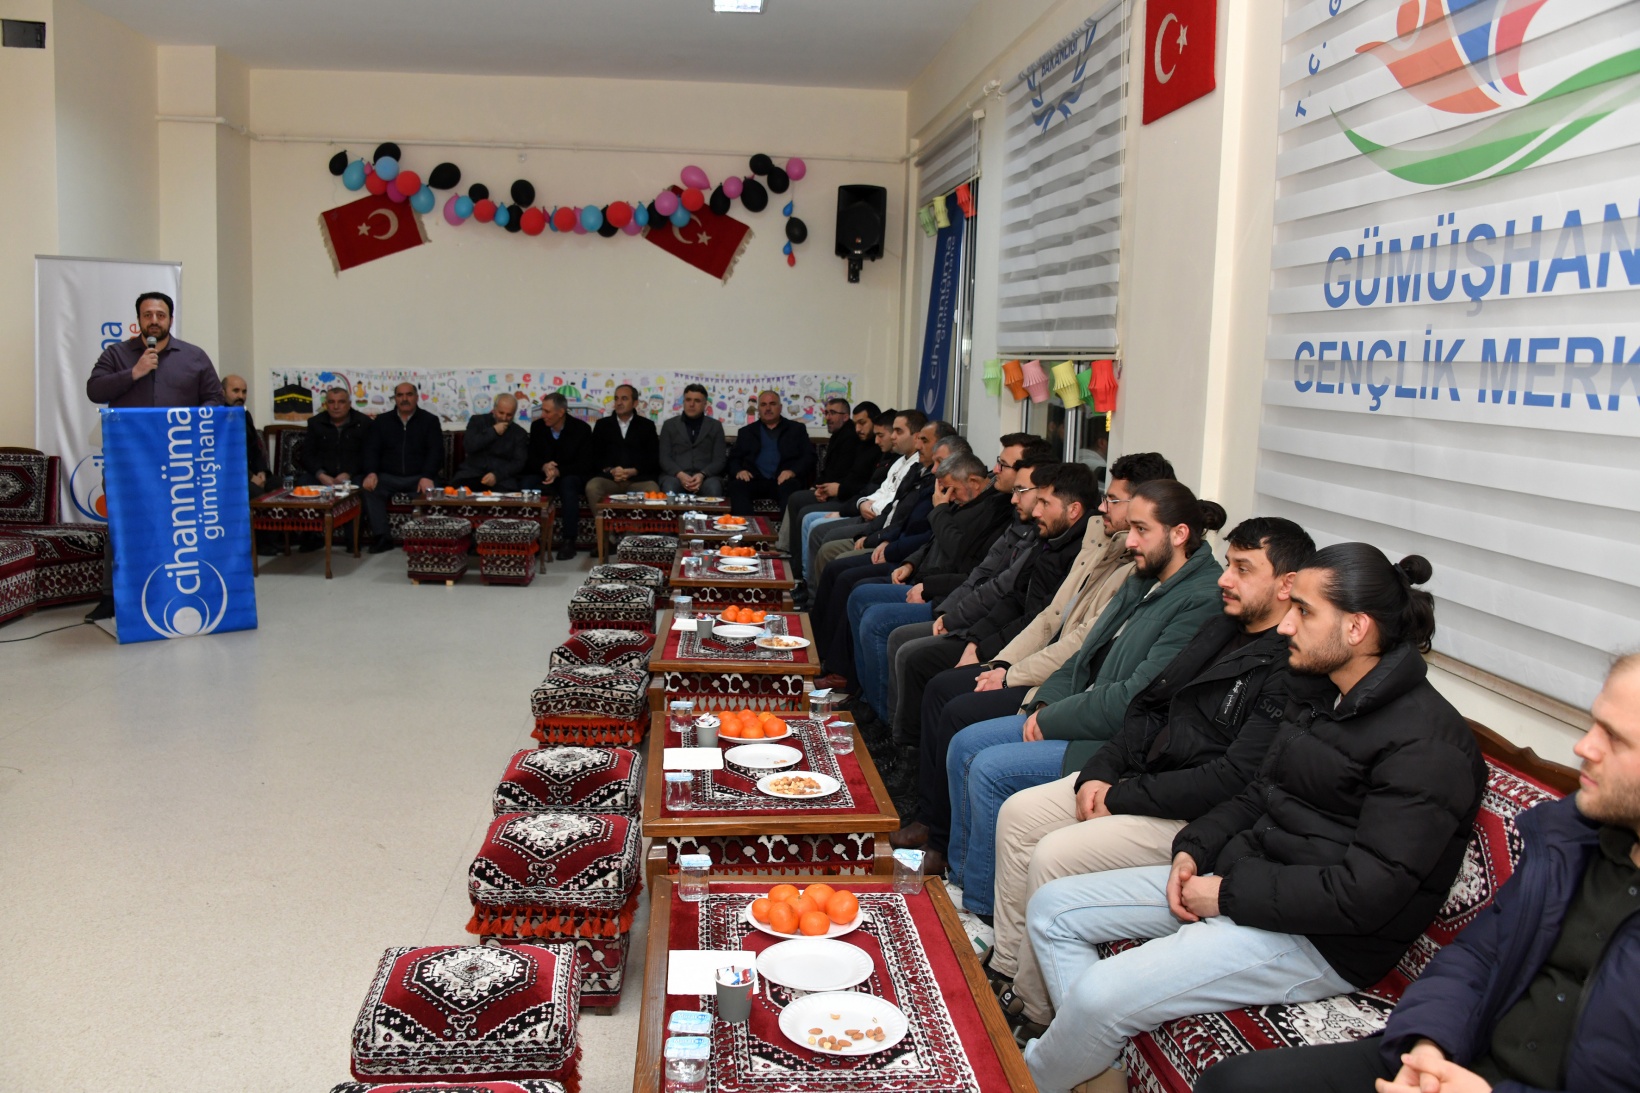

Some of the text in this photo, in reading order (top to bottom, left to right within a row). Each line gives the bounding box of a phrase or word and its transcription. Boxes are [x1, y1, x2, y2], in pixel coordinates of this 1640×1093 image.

[1323, 196, 1640, 317] GÜMÜŞHAN
[1294, 323, 1640, 412] GENÇLİK MERK
[161, 406, 201, 595] cihannüma
[195, 406, 225, 540] gümüşhane
[1259, 698, 1284, 719] Sup
